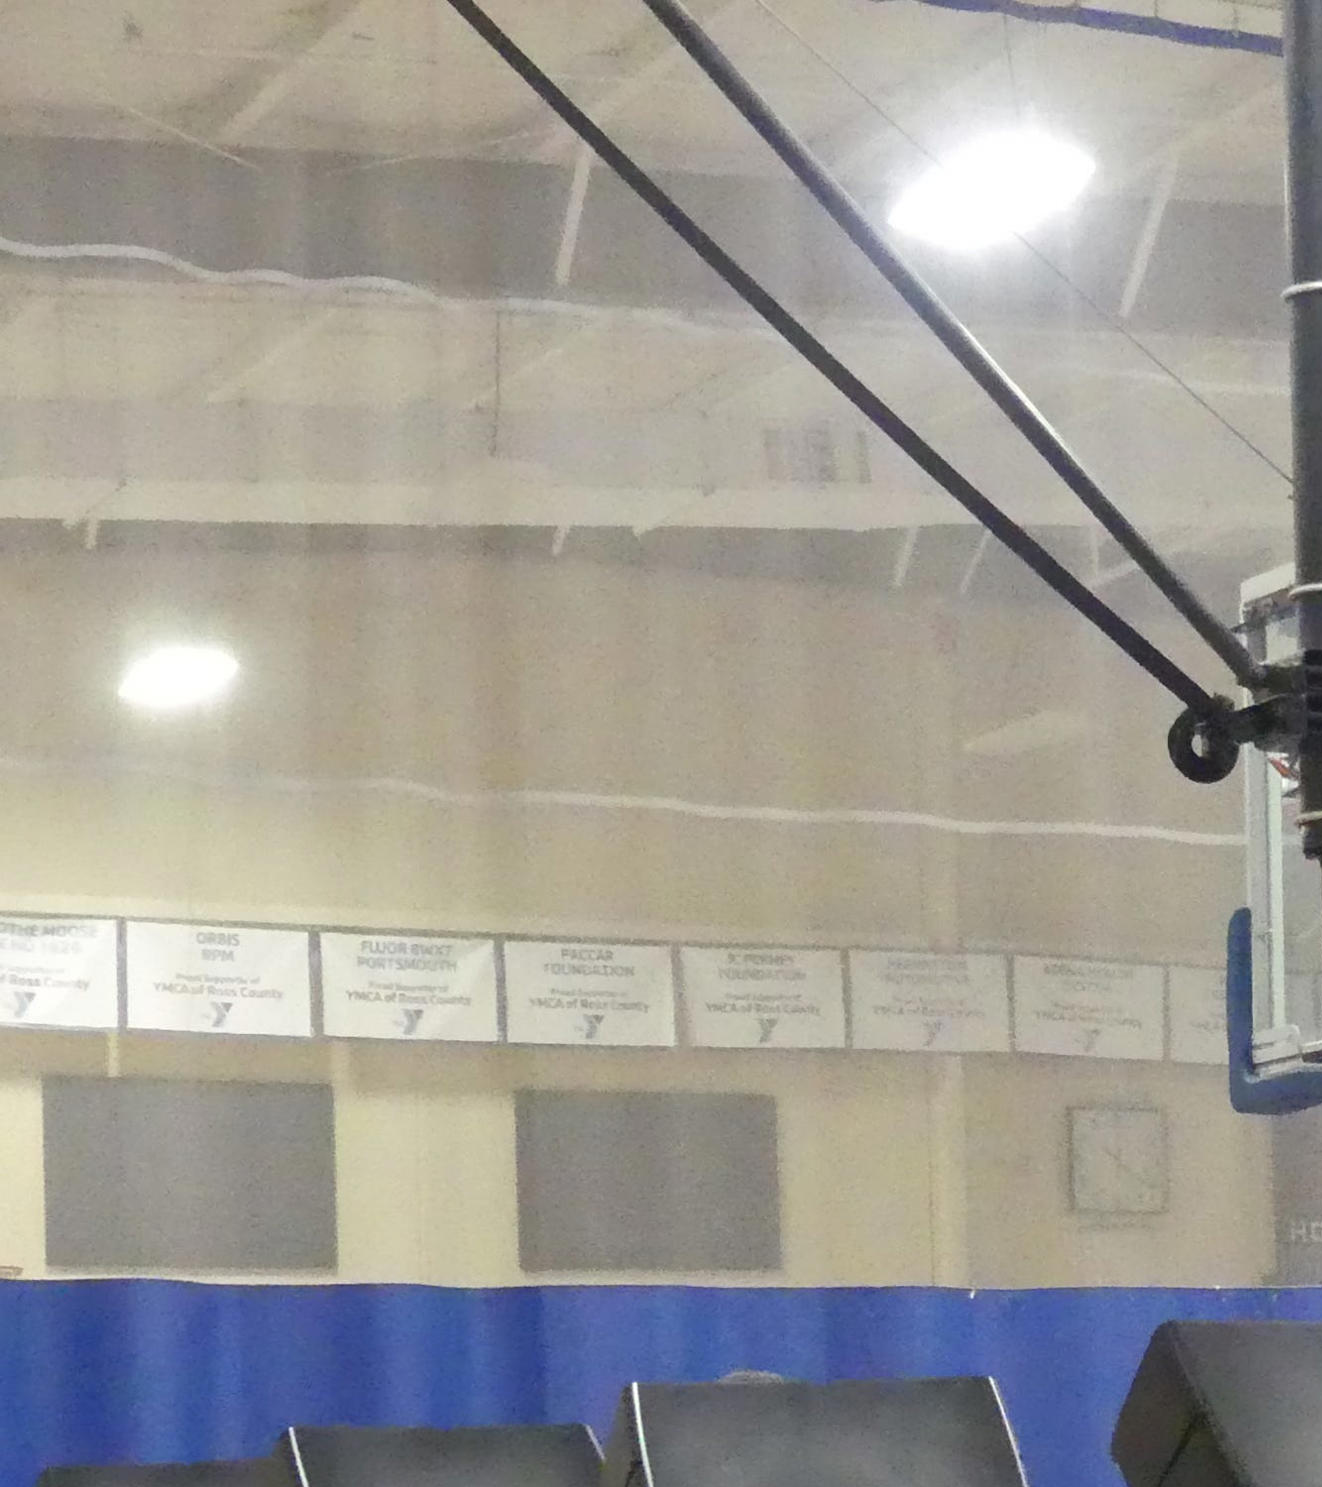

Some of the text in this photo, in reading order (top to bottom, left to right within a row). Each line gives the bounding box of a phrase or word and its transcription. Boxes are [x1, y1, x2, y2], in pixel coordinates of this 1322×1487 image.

[196, 932, 241, 947] ORBIS
[201, 948, 235, 962] RPM
[561, 948, 614, 961] PACCAR
[357, 956, 457, 972] PORTSMOUTH
[543, 963, 635, 977] FOUNDATION
[153, 982, 189, 994] YMCA
[206, 985, 237, 997] Ross
[240, 987, 284, 1000] County
[345, 990, 383, 1002] YMCA
[529, 997, 563, 1009] YMCA
